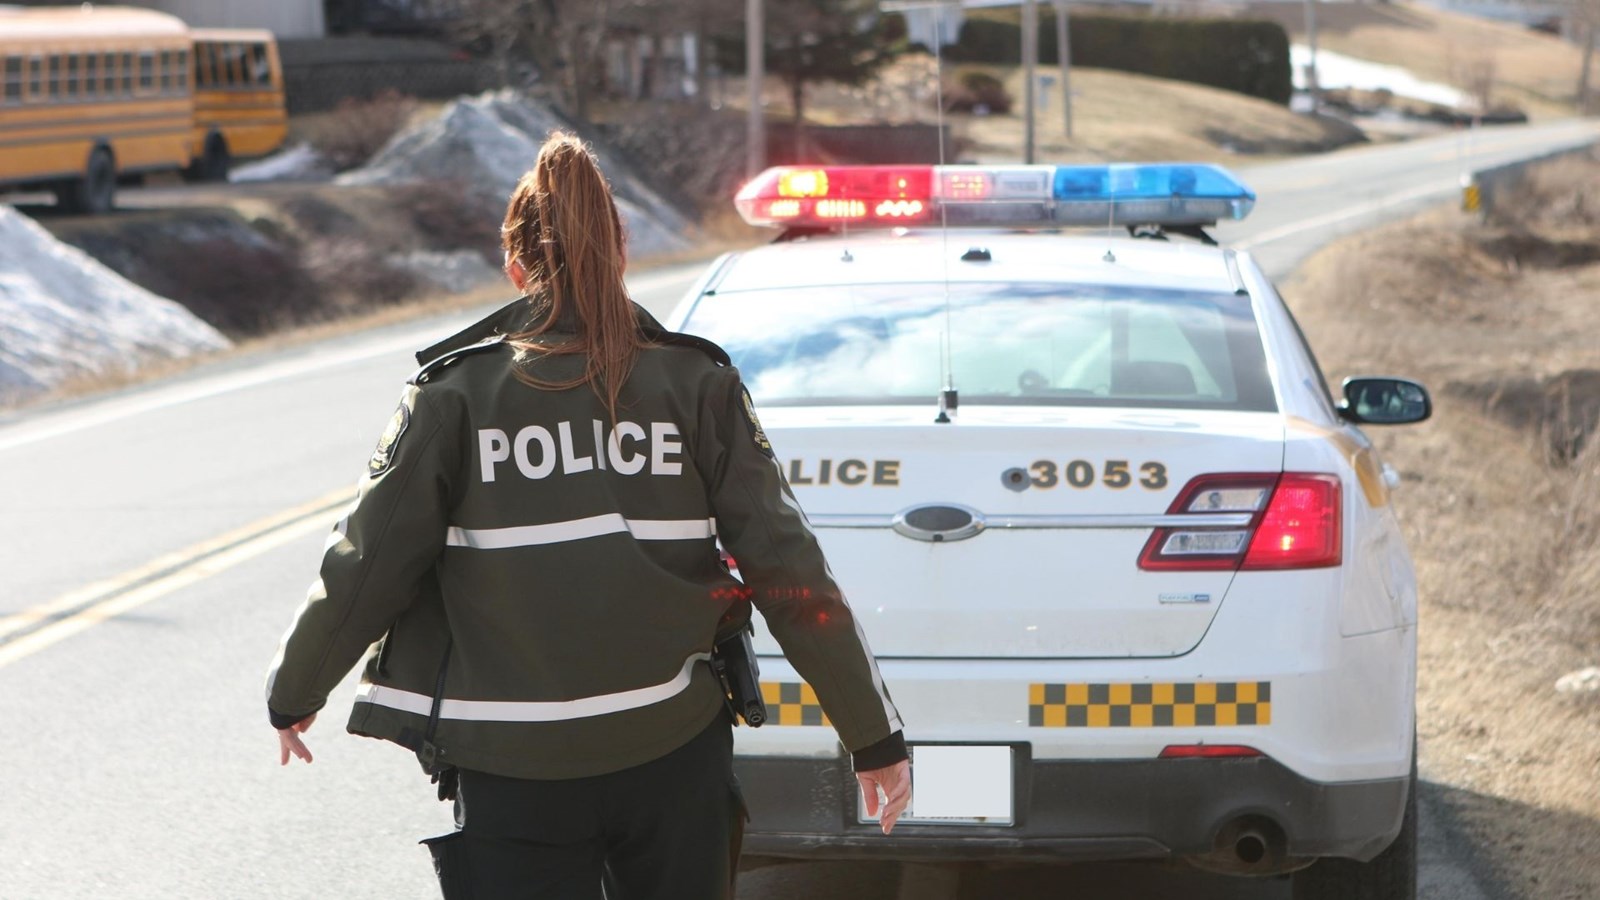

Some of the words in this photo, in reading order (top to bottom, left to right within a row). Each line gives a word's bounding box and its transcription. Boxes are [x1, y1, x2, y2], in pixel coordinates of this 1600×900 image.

[478, 419, 683, 482] POLICE
[786, 458, 901, 487] LICE
[1029, 459, 1169, 490] 3053
